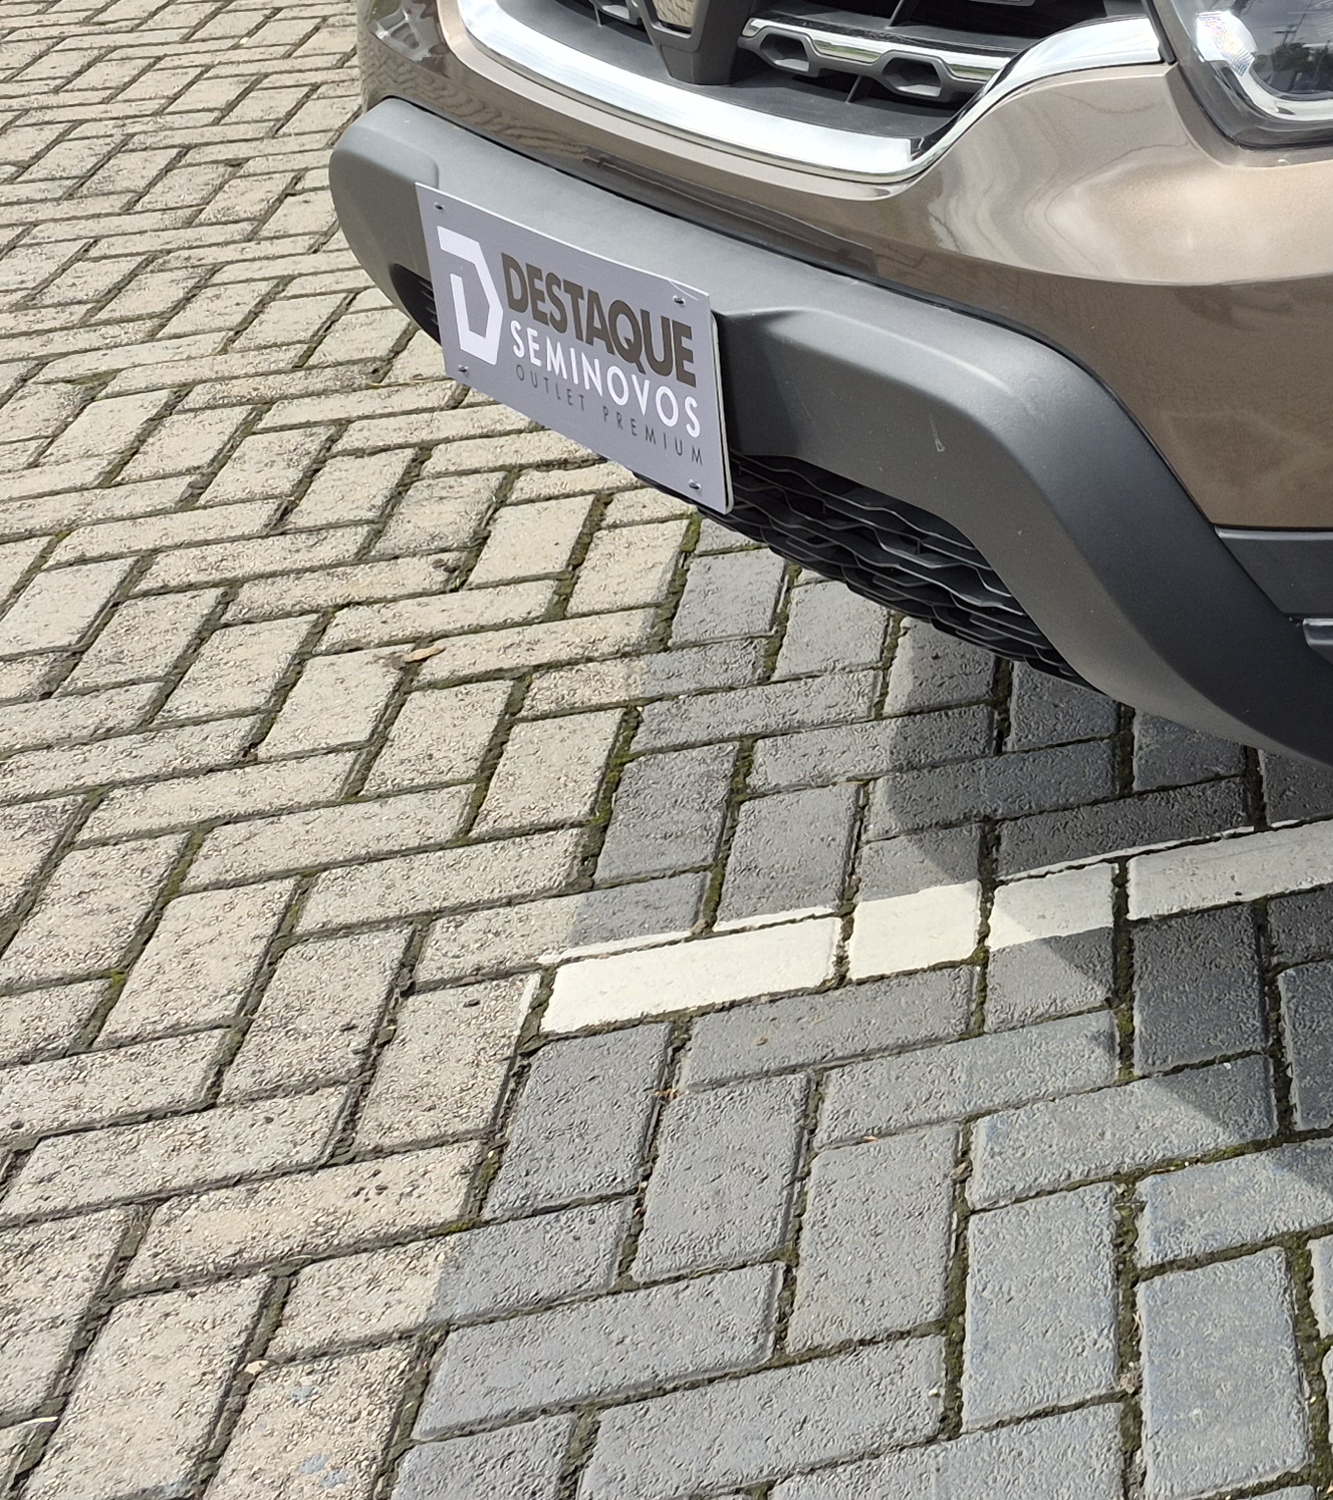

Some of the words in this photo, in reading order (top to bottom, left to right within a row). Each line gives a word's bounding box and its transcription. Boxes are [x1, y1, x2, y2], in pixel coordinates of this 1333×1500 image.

[501, 252, 698, 388] DESTAQUE
[509, 320, 702, 438] SEMINOVOS
[515, 363, 587, 413] OUTLET
[603, 405, 704, 466] PREMIUM
